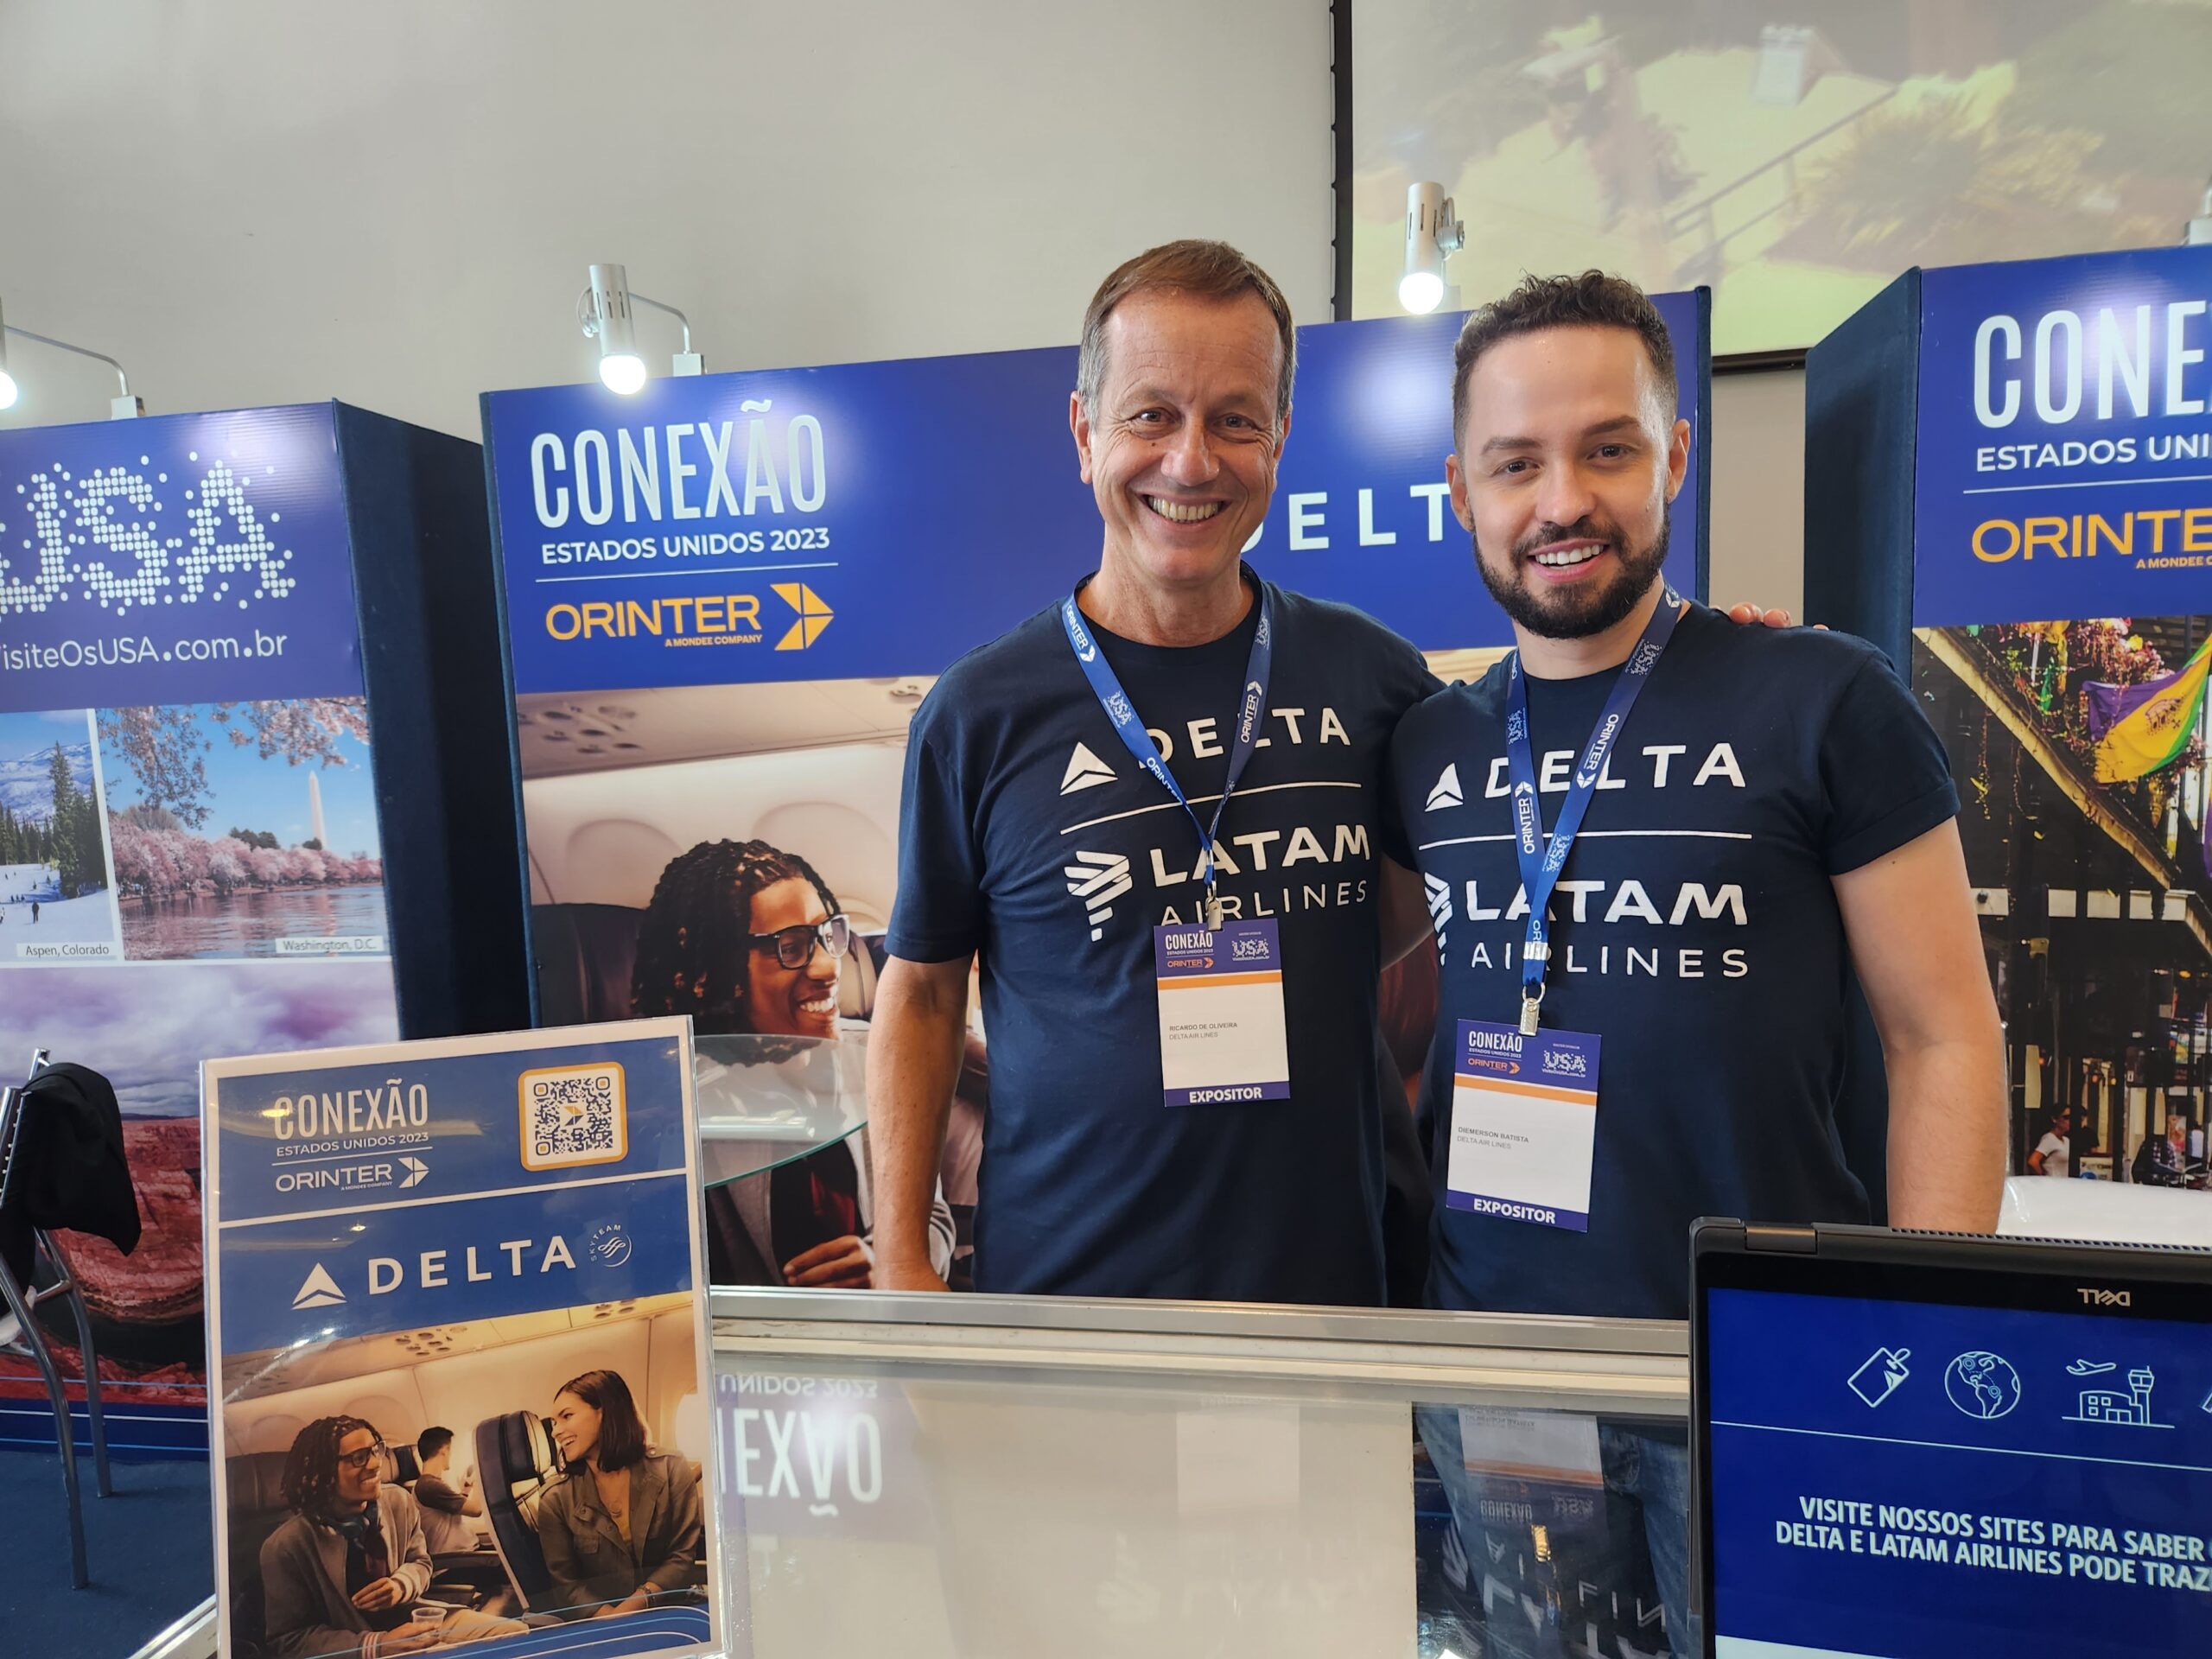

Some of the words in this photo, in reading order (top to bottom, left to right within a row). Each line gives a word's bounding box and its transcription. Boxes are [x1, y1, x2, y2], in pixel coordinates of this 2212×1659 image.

[1974, 301, 2212, 429] CONE
[531, 399, 826, 528] CONEXÃO
[1977, 438, 2137, 472] ESTADOS
[2148, 434, 2212, 461] UNI
[1241, 483, 1451, 554] ELT
[1972, 508, 2212, 563] ORINTE
[542, 537, 658, 564] ESTADOS
[663, 531, 764, 558] UNIDOS
[770, 527, 830, 552] 2023
[2136, 558, 2145, 569] A
[2148, 556, 2204, 569] MONDEE
[545, 594, 762, 640] ORINTER
[1066, 605, 1089, 649] ORINTER
[0, 629, 288, 670] isiteOsUSA.com.br
[664, 639, 672, 647] A
[674, 637, 713, 647] MONDEE
[715, 634, 762, 645] COMPANY
[1241, 694, 1256, 743] ORINTER
[1586, 714, 1619, 770] ORINTER
[1518, 798, 1535, 855] ORINTER
[26, 944, 60, 958] Aspen,
[62, 944, 110, 955] Colorado
[1165, 930, 1213, 950] CONEXÃO
[1232, 938, 1269, 957] USA
[1167, 959, 1203, 968] ORINTER
[1471, 942, 1749, 978] AILINES
[1469, 1031, 1522, 1052] CONEXÃO
[1468, 1058, 1508, 1071] ORINTER
[274, 1078, 429, 1141] CONEXÃO
[1189, 1086, 1262, 1103] EXPOSITOR
[276, 1141, 340, 1157] ESTADOS
[343, 1135, 396, 1150] UNIDOS
[399, 1132, 429, 1144] 2023
[1458, 1127, 1498, 1138] DIEMERSON
[1500, 1133, 1529, 1142] BATISTA
[276, 1164, 393, 1192] ORINTER
[1473, 1198, 1556, 1224] EXPOSITOR
[588, 1224, 621, 1262] SKYTEAM
[368, 1235, 576, 1295] DELTA
[2076, 1288, 2131, 1307] DELL
[1799, 1496, 1873, 1526] VISITE
[1879, 1504, 1974, 1537] NOSSOS
[1980, 1516, 2045, 1545] SITES
[2051, 1522, 2118, 1553] PARA
[2123, 1530, 2206, 1561] SABER
[1776, 1521, 1845, 1551] DELTA
[1850, 1529, 1864, 1553] E
[1869, 1531, 1948, 1563] LATAM
[1954, 1541, 2063, 1575] AIRLINES
[2069, 1553, 2137, 1584] PODE
[2142, 1560, 2212, 1592] TRAZ
